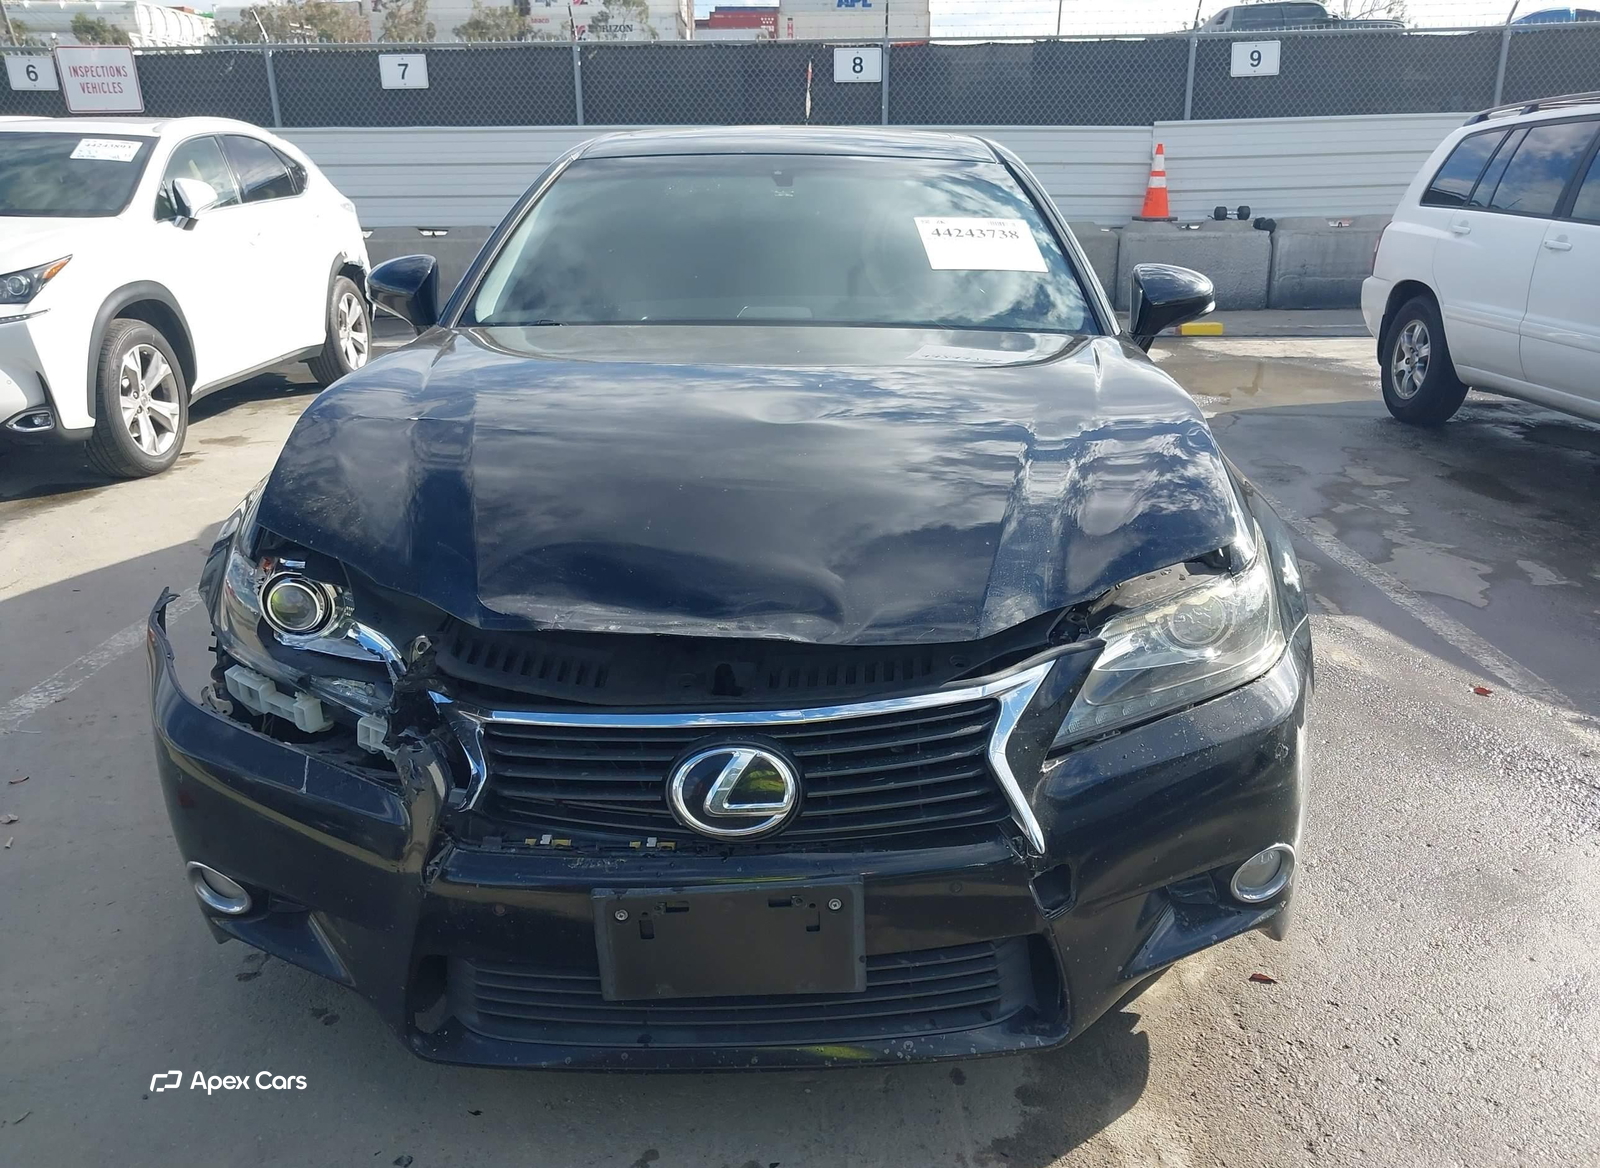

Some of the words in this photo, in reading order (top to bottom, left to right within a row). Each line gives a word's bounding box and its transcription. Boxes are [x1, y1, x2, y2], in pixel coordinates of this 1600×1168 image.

[852, 56, 863, 74] 8
[1249, 49, 1262, 68] 9
[25, 64, 39, 82] 6
[68, 65, 128, 78] INSPECTIONS
[397, 63, 409, 80] 7
[79, 82, 124, 94] VEHICLES
[931, 227, 1020, 240] 44243738
